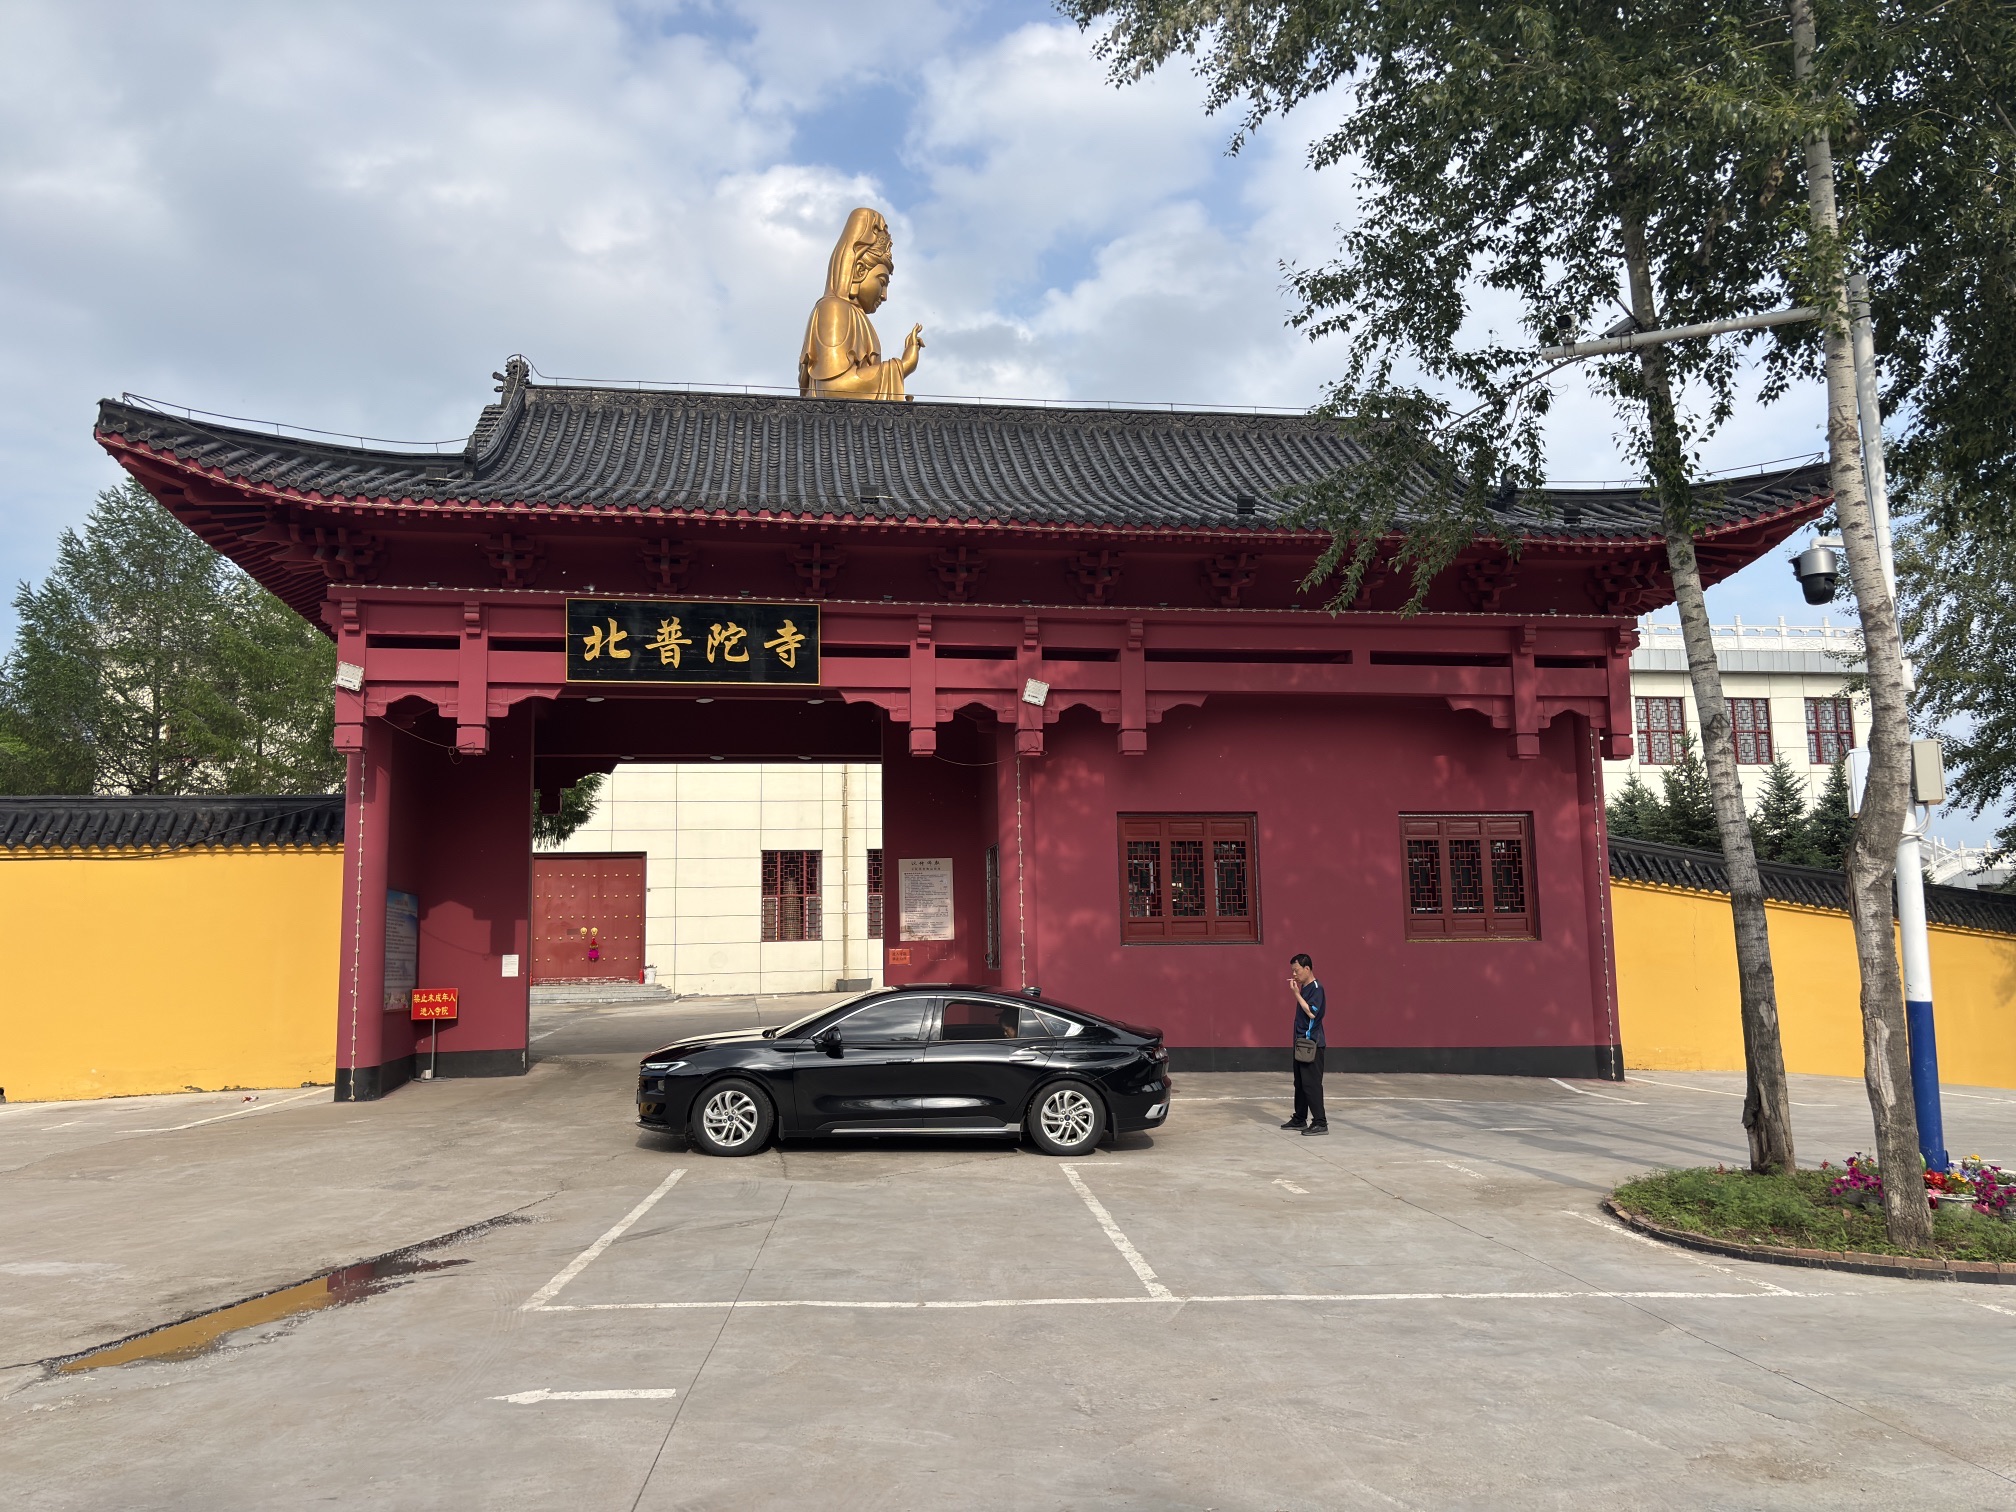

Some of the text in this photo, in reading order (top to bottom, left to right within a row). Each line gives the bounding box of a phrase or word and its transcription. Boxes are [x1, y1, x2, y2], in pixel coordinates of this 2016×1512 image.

[583, 616, 806, 669] 北普陀寺
[413, 992, 456, 1003] 禁止未成年人
